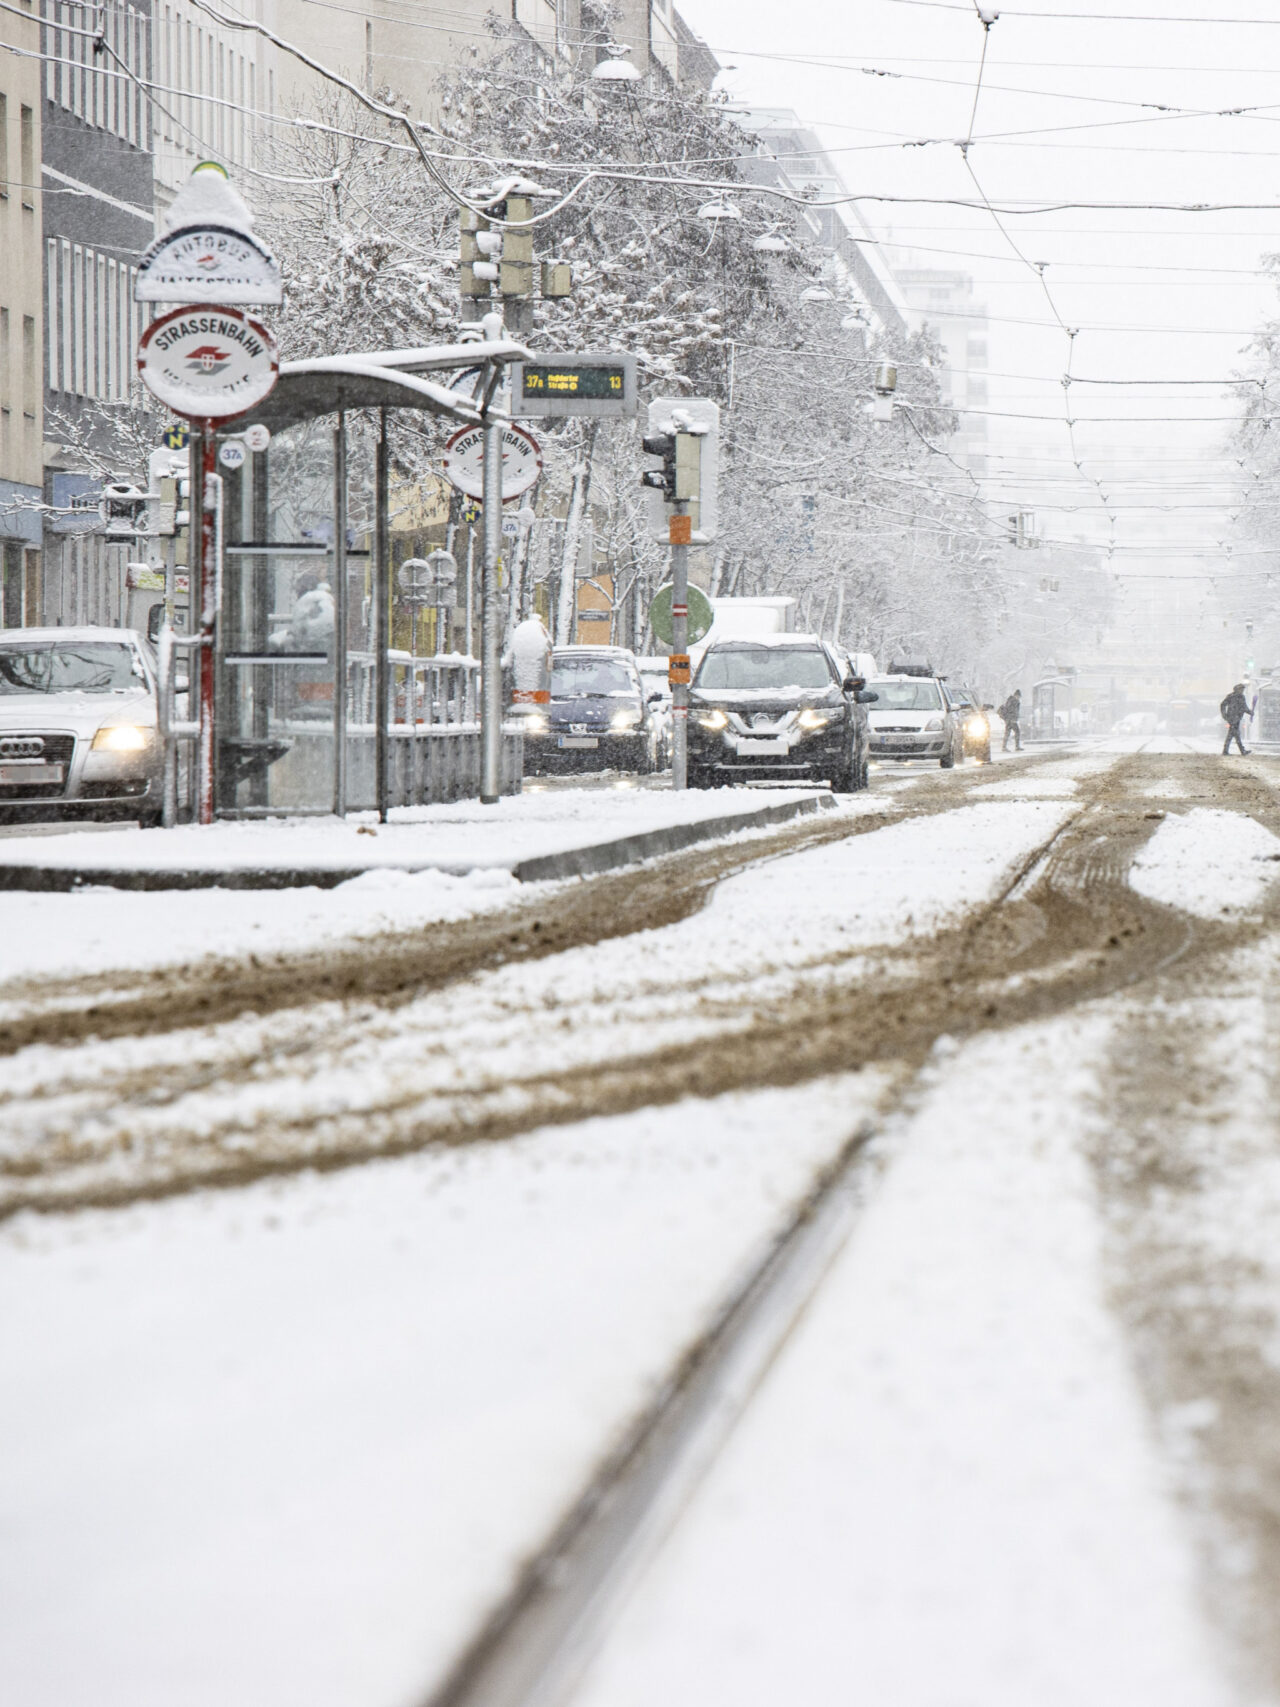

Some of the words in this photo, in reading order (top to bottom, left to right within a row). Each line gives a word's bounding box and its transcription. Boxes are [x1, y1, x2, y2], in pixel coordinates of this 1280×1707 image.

[155, 318, 264, 358] STRASSENBAHN
[609, 376, 622, 389] 13
[169, 434, 183, 449] N
[223, 449, 242, 460] 37A
[466, 512, 476, 522] N
